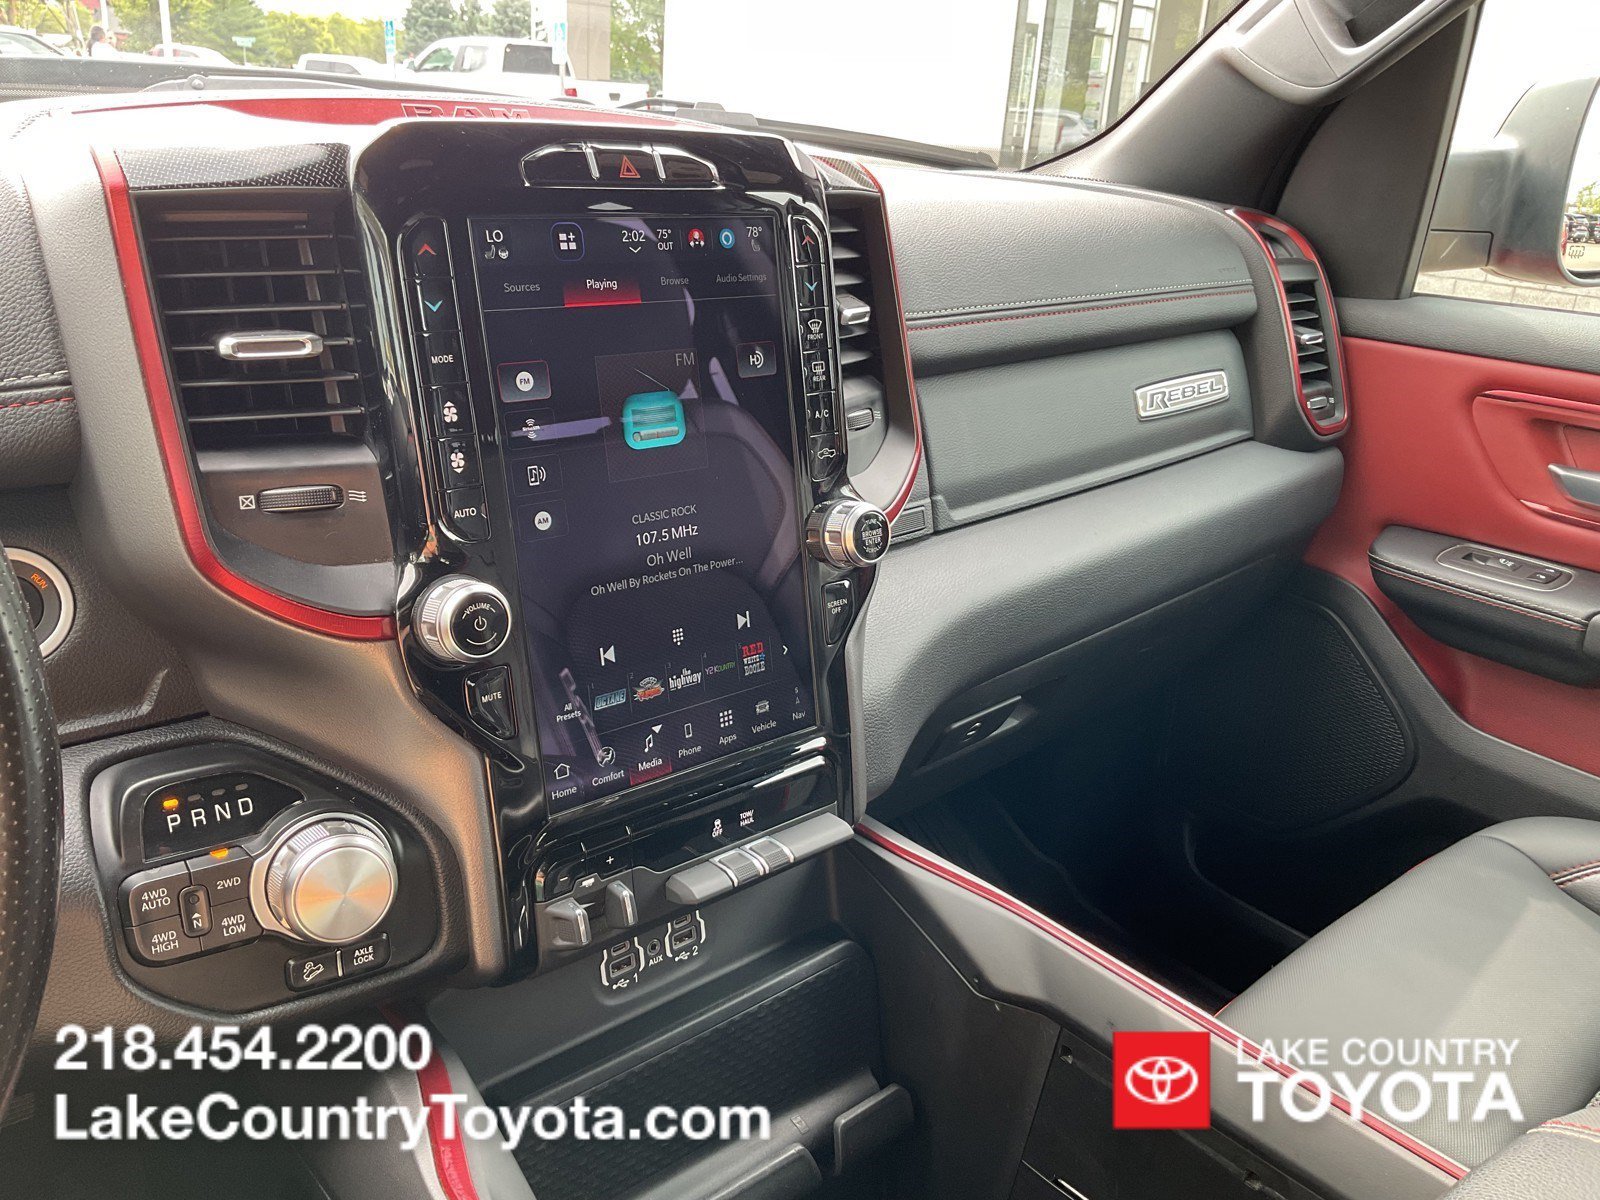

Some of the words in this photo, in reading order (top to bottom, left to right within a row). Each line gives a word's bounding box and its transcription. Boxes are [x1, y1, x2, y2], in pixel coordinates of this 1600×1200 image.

[401, 103, 531, 119] RAM
[485, 230, 503, 243] LO
[621, 230, 646, 242] 2:02
[657, 241, 674, 251] OUT
[660, 276, 689, 286] Browse
[716, 273, 736, 283] Audio
[737, 272, 767, 284] Settings
[503, 282, 541, 293] Sources
[586, 279, 618, 292] Playing
[807, 332, 824, 341] FRONT
[431, 354, 454, 364] MODE
[675, 352, 695, 367] FM
[519, 378, 531, 386] FM
[1146, 379, 1223, 410] REBEL
[815, 409, 830, 419] A/C
[453, 507, 477, 519] AUTO
[631, 509, 669, 525] CLASSIC
[670, 504, 697, 519] ROCK
[537, 516, 550, 525] AM
[635, 528, 669, 547] 107.5
[671, 524, 699, 540] MHz
[861, 527, 883, 539] BROWSE
[865, 536, 882, 546] ENTER
[646, 553, 664, 567] Oh
[667, 547, 692, 562] Well
[30, 573, 48, 590] RUN
[590, 584, 605, 596] Oh
[606, 579, 628, 592] Well
[629, 577, 641, 589] By
[642, 570, 677, 585] Rockets
[679, 566, 692, 576] On
[693, 562, 708, 574] The
[464, 602, 491, 615] VOLUME
[827, 598, 848, 609] SCREEN
[831, 606, 842, 615] OFF
[742, 641, 764, 657] RED
[682, 667, 692, 675] the
[669, 671, 702, 690] highway
[481, 691, 502, 703] MUTE
[595, 690, 626, 708] OCTANE
[564, 703, 573, 711] All
[556, 709, 582, 723] Presets
[551, 785, 577, 800] Home
[592, 769, 625, 787] Comfort
[638, 757, 663, 771] Media
[678, 744, 702, 758] Phone
[718, 733, 737, 745] Apps
[751, 718, 777, 734] Vehicle
[792, 711, 806, 720] Nav
[167, 815, 181, 834] P
[190, 808, 207, 827] R
[214, 802, 232, 821] N
[238, 797, 254, 816] D
[740, 817, 755, 827] HAUL
[712, 828, 723, 838] OFF
[216, 876, 241, 890] 2WD
[141, 888, 168, 901] 4WD
[141, 896, 171, 912] AUTO
[193, 918, 202, 928] N
[221, 914, 245, 928] 4WD
[223, 922, 246, 937] LOW
[151, 930, 177, 944] 4WD
[151, 940, 179, 955] HIGH
[354, 945, 374, 958] AXLE
[692, 945, 698, 956] 2
[353, 953, 374, 966] LOCK
[648, 954, 663, 966] AUX
[634, 973, 639, 983] 1
